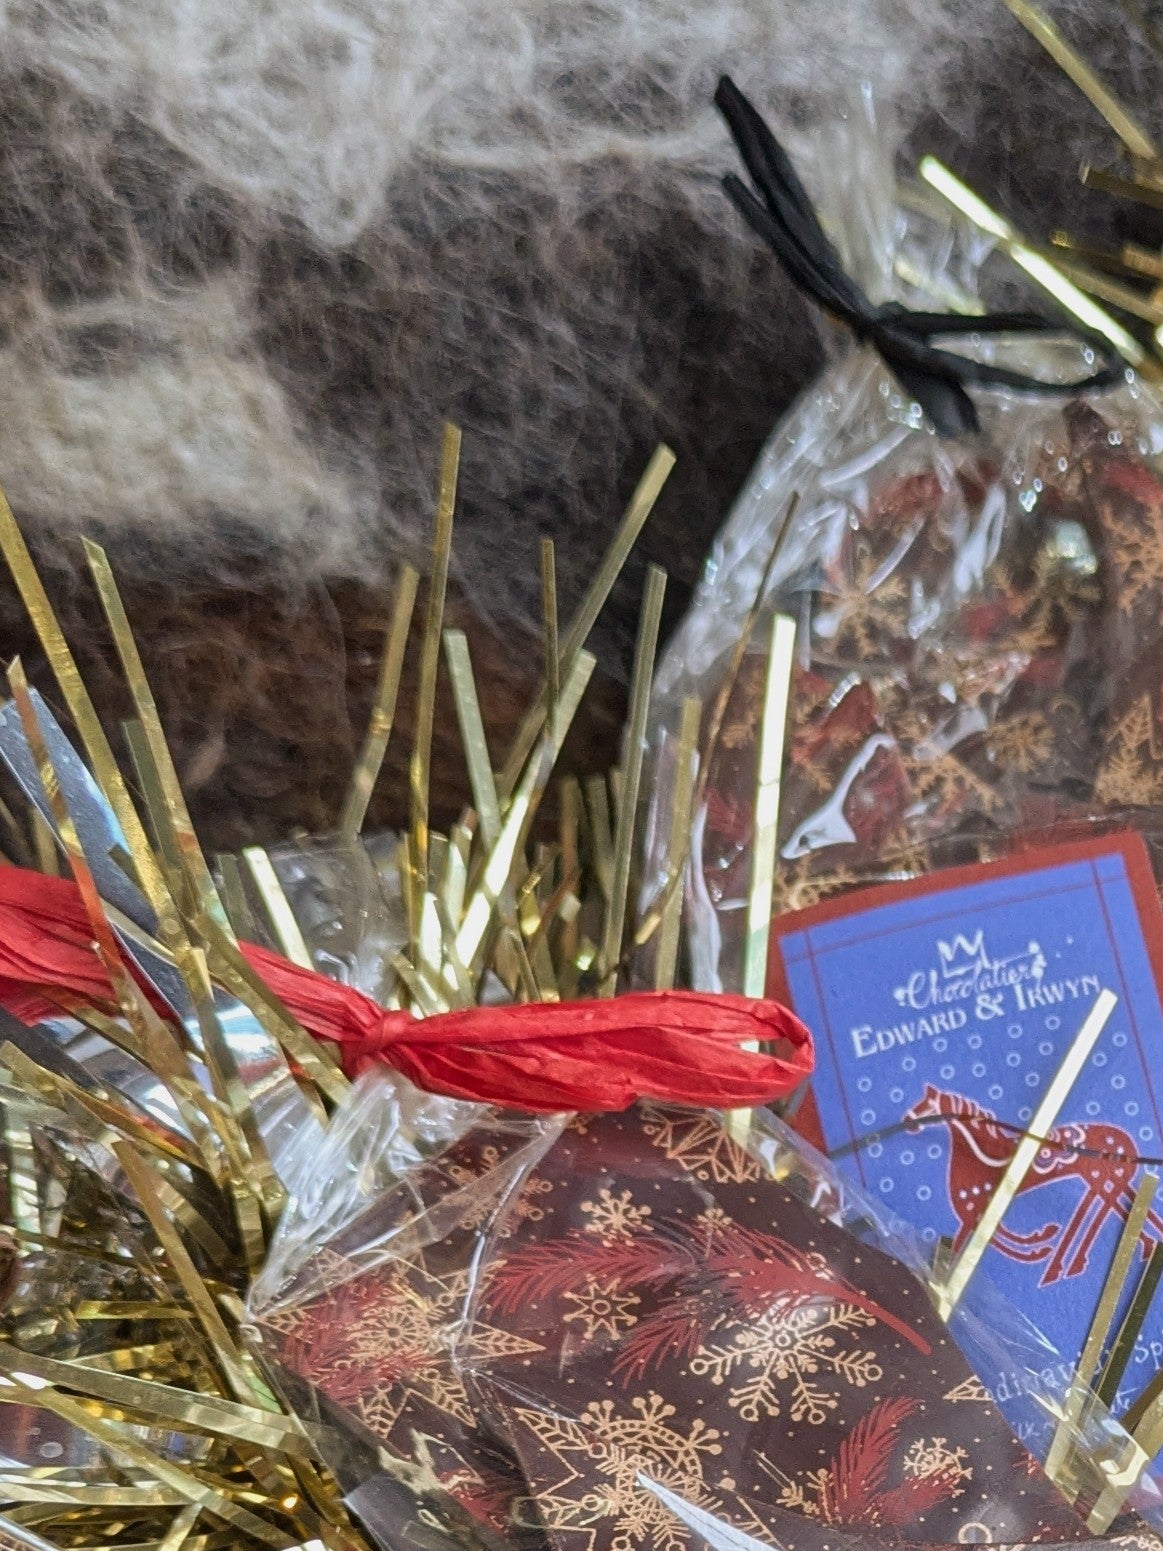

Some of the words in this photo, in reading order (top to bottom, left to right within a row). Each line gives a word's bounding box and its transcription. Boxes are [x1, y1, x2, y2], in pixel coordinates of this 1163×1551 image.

[850, 1007, 968, 1059] EDWARD
[974, 992, 1005, 1021] &
[1013, 973, 1101, 1012] IRWYN
